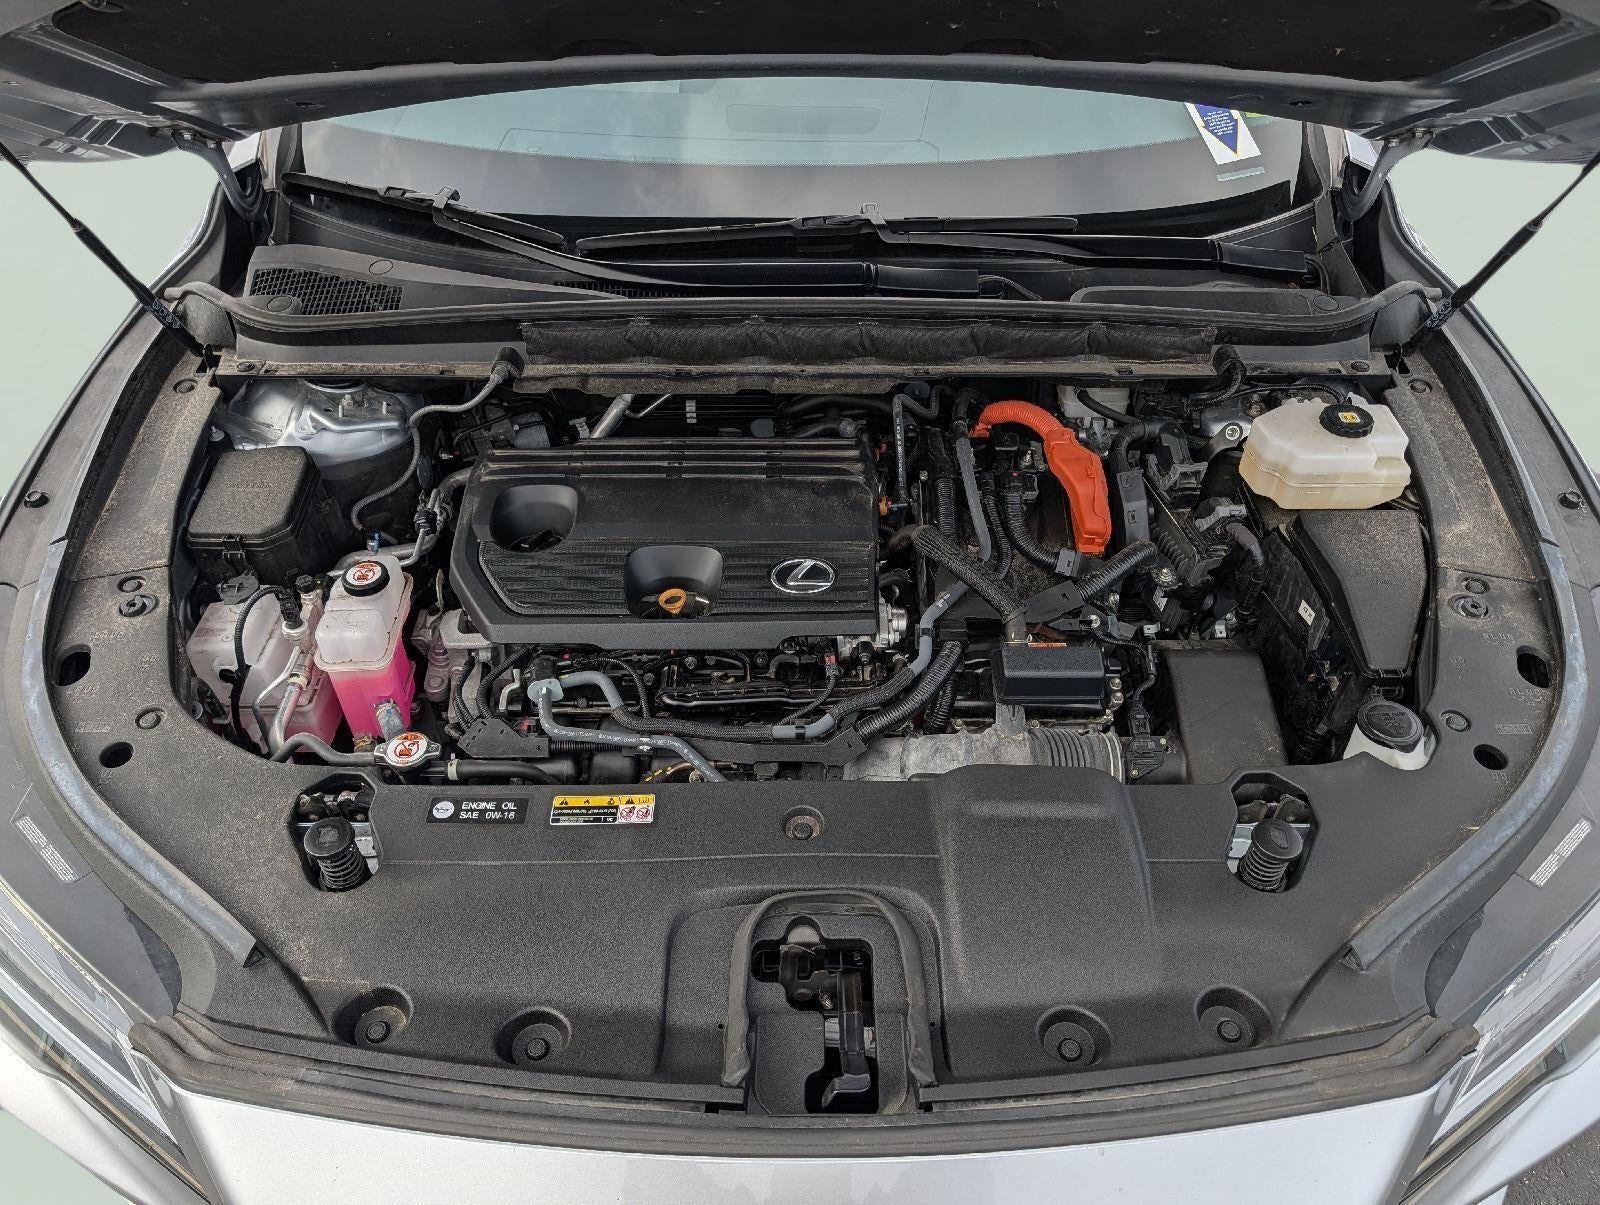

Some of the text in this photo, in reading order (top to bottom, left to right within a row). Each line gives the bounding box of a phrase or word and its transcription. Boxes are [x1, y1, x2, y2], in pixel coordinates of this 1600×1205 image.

[461, 801, 517, 810] ENGINE OIL
[459, 811, 480, 819] SAE
